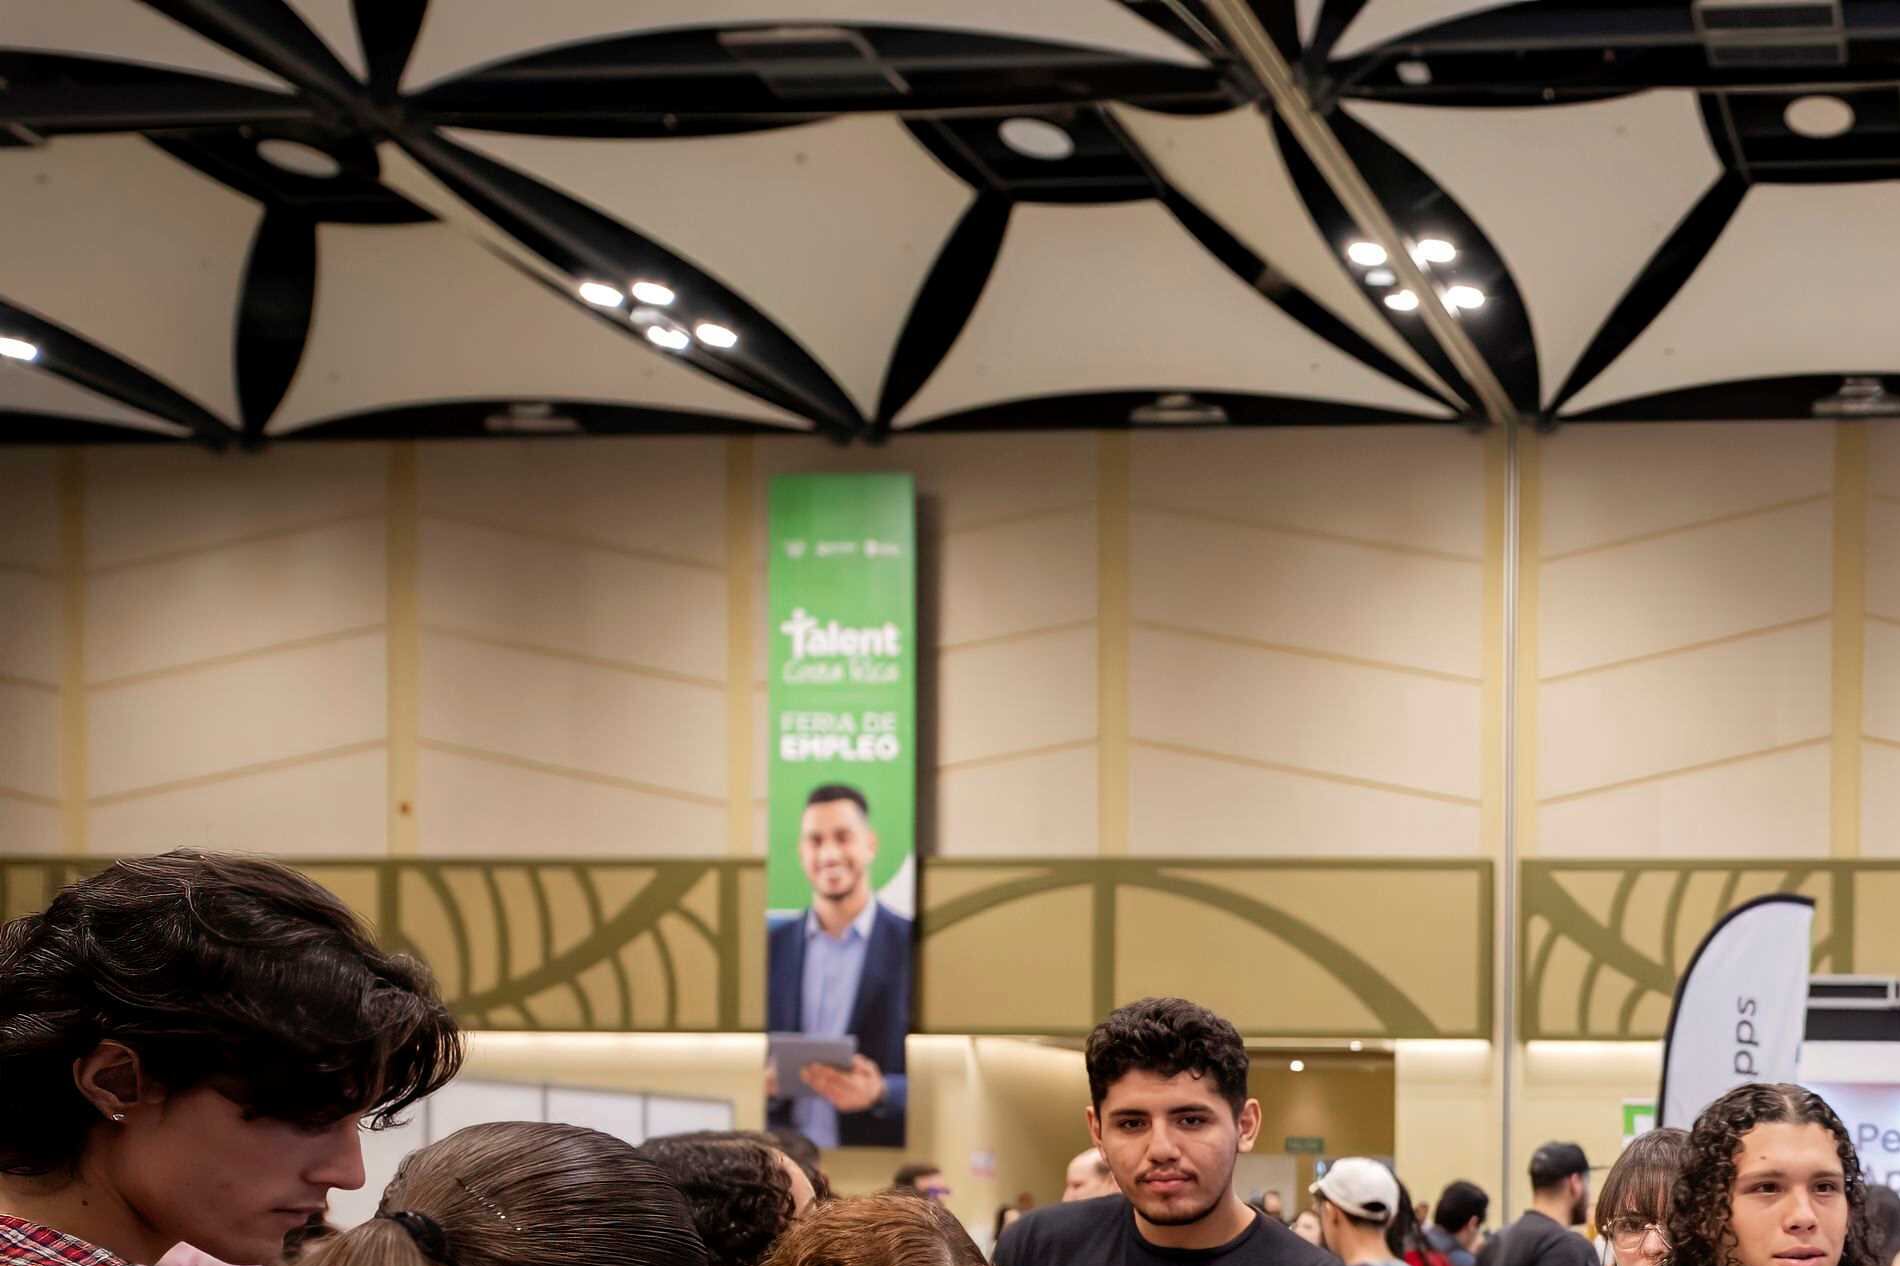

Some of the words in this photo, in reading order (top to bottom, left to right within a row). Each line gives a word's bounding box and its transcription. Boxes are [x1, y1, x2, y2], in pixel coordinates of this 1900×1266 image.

[780, 608, 901, 659] Talent
[780, 711, 856, 733] FERIA
[862, 711, 897, 733] DE
[779, 734, 899, 761] EMPLEO
[1734, 996, 1759, 1082] pps
